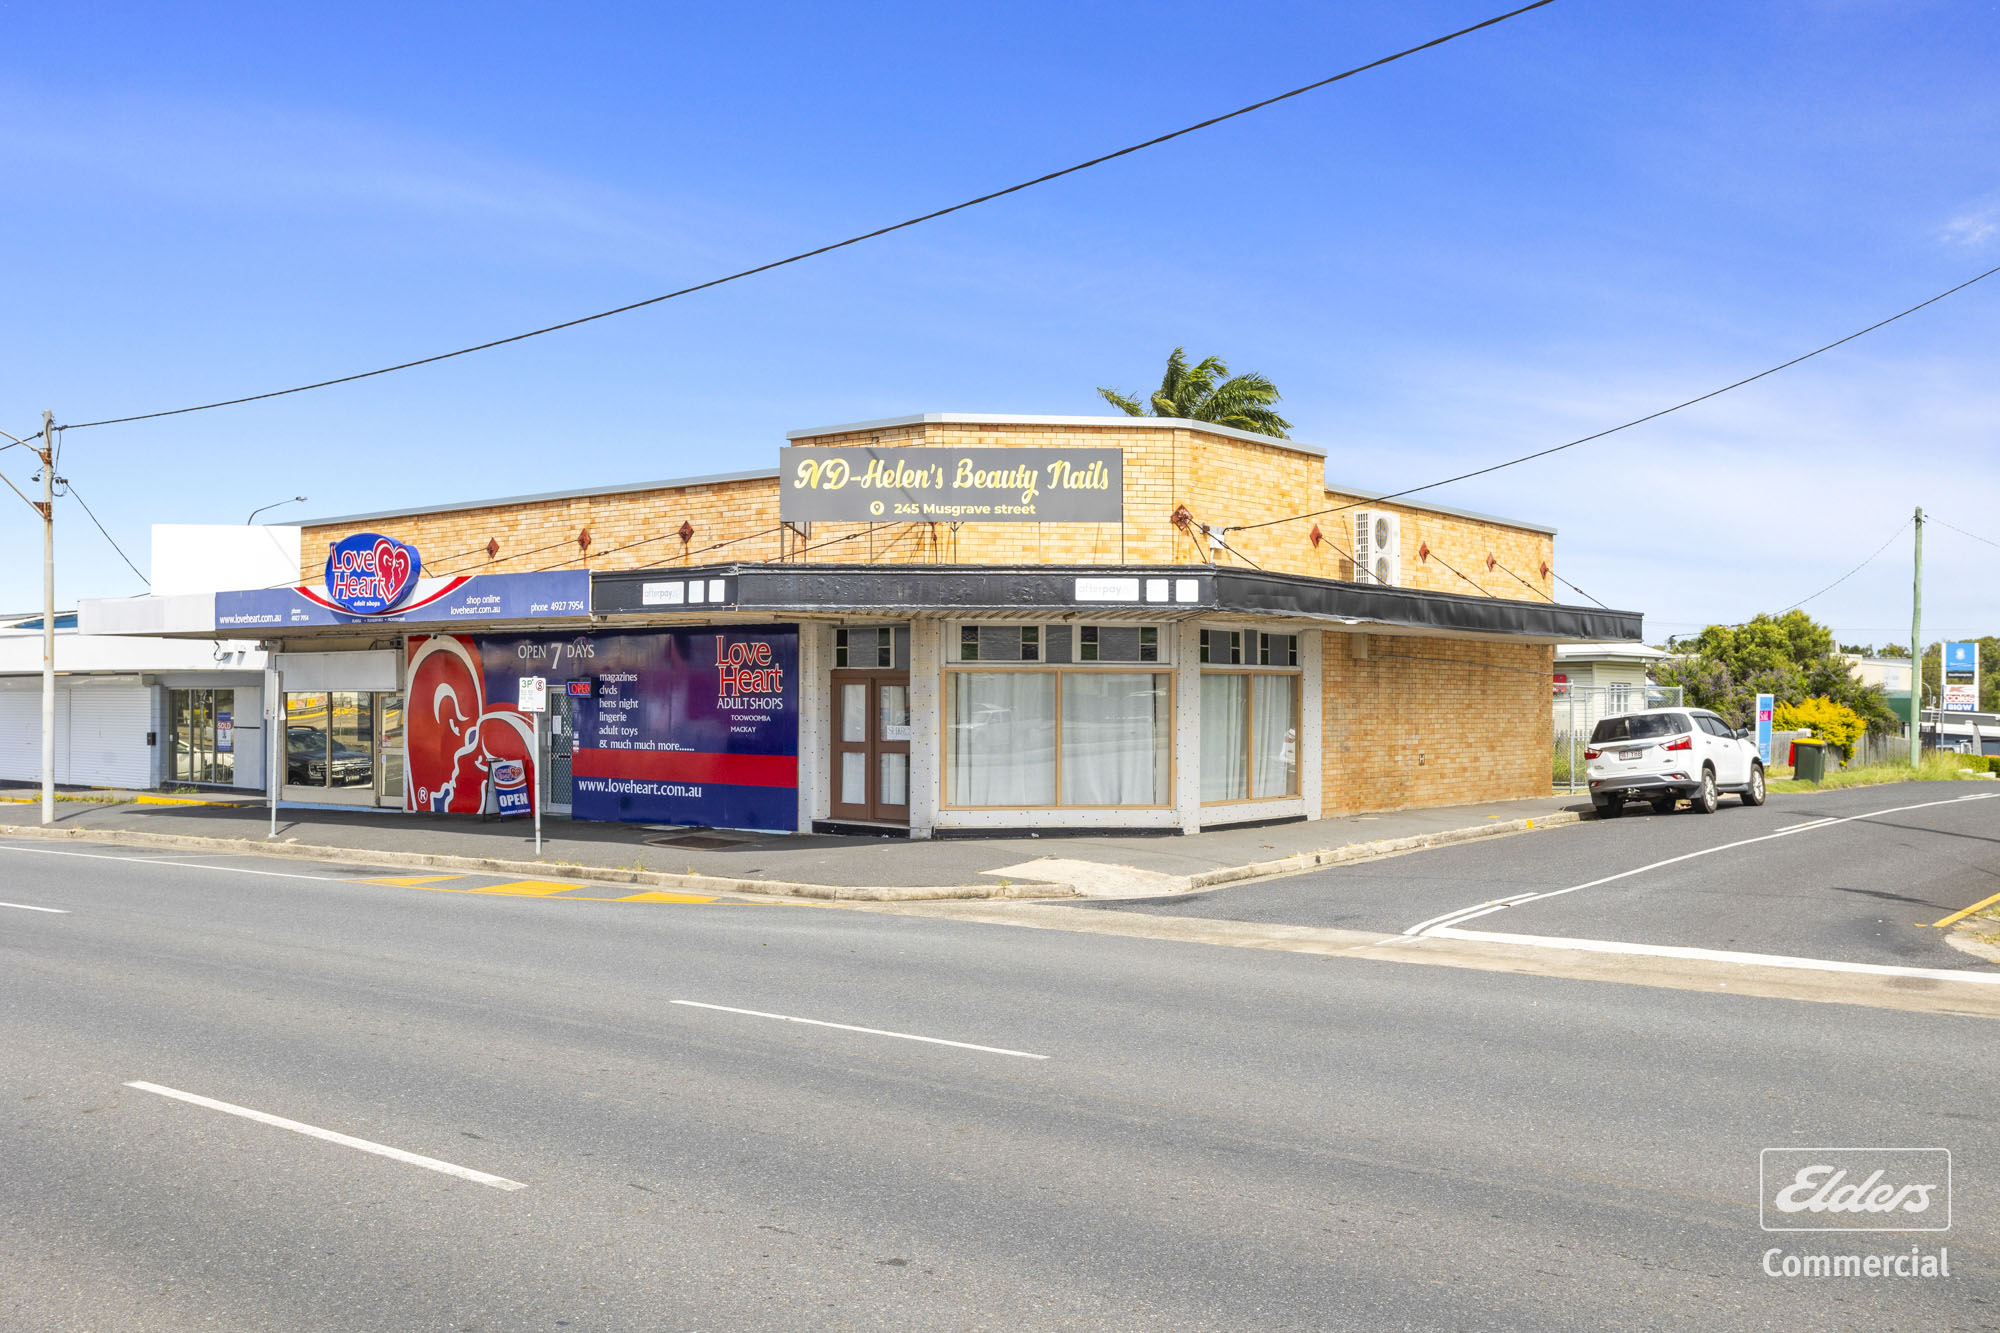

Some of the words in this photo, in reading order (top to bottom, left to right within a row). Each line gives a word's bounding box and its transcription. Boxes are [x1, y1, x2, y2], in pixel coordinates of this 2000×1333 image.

[793, 457, 944, 490] ND-Helen's
[952, 457, 1040, 504] Beauty
[1047, 459, 1109, 490] Nails
[893, 502, 920, 514] 245
[923, 503, 991, 516] Musgrave
[994, 503, 1037, 514] street
[331, 543, 376, 572] Love
[333, 572, 386, 599] Heart
[466, 595, 482, 605] shop
[482, 594, 501, 604] online
[450, 605, 501, 615] loveheart.com.au
[530, 602, 548, 614] phone
[550, 601, 567, 611] 4927
[568, 600, 584, 611] 7954
[219, 613, 282, 624] www.loveheart.com.au
[517, 644, 547, 659] OPEN
[550, 642, 563, 670] 7
[567, 644, 595, 658] DAYS
[715, 635, 773, 666] Love
[599, 671, 638, 683] magazines
[718, 663, 783, 697] Heart
[570, 683, 591, 694] OPEN
[599, 685, 618, 695] dvds
[599, 698, 617, 708] hens
[618, 698, 639, 710] night
[716, 697, 749, 709] ADULT
[749, 697, 783, 710] SHOPS
[599, 711, 627, 723] lingerie
[730, 714, 771, 722] TOOWOOMBA
[217, 722, 232, 730] SOLD
[598, 725, 619, 735] adult
[621, 726, 639, 737] toys
[599, 739, 608, 749] &
[610, 739, 632, 749] much
[634, 740, 656, 750] much
[578, 778, 702, 798] www.loveheart.com.au
[499, 793, 528, 807] OPEN
